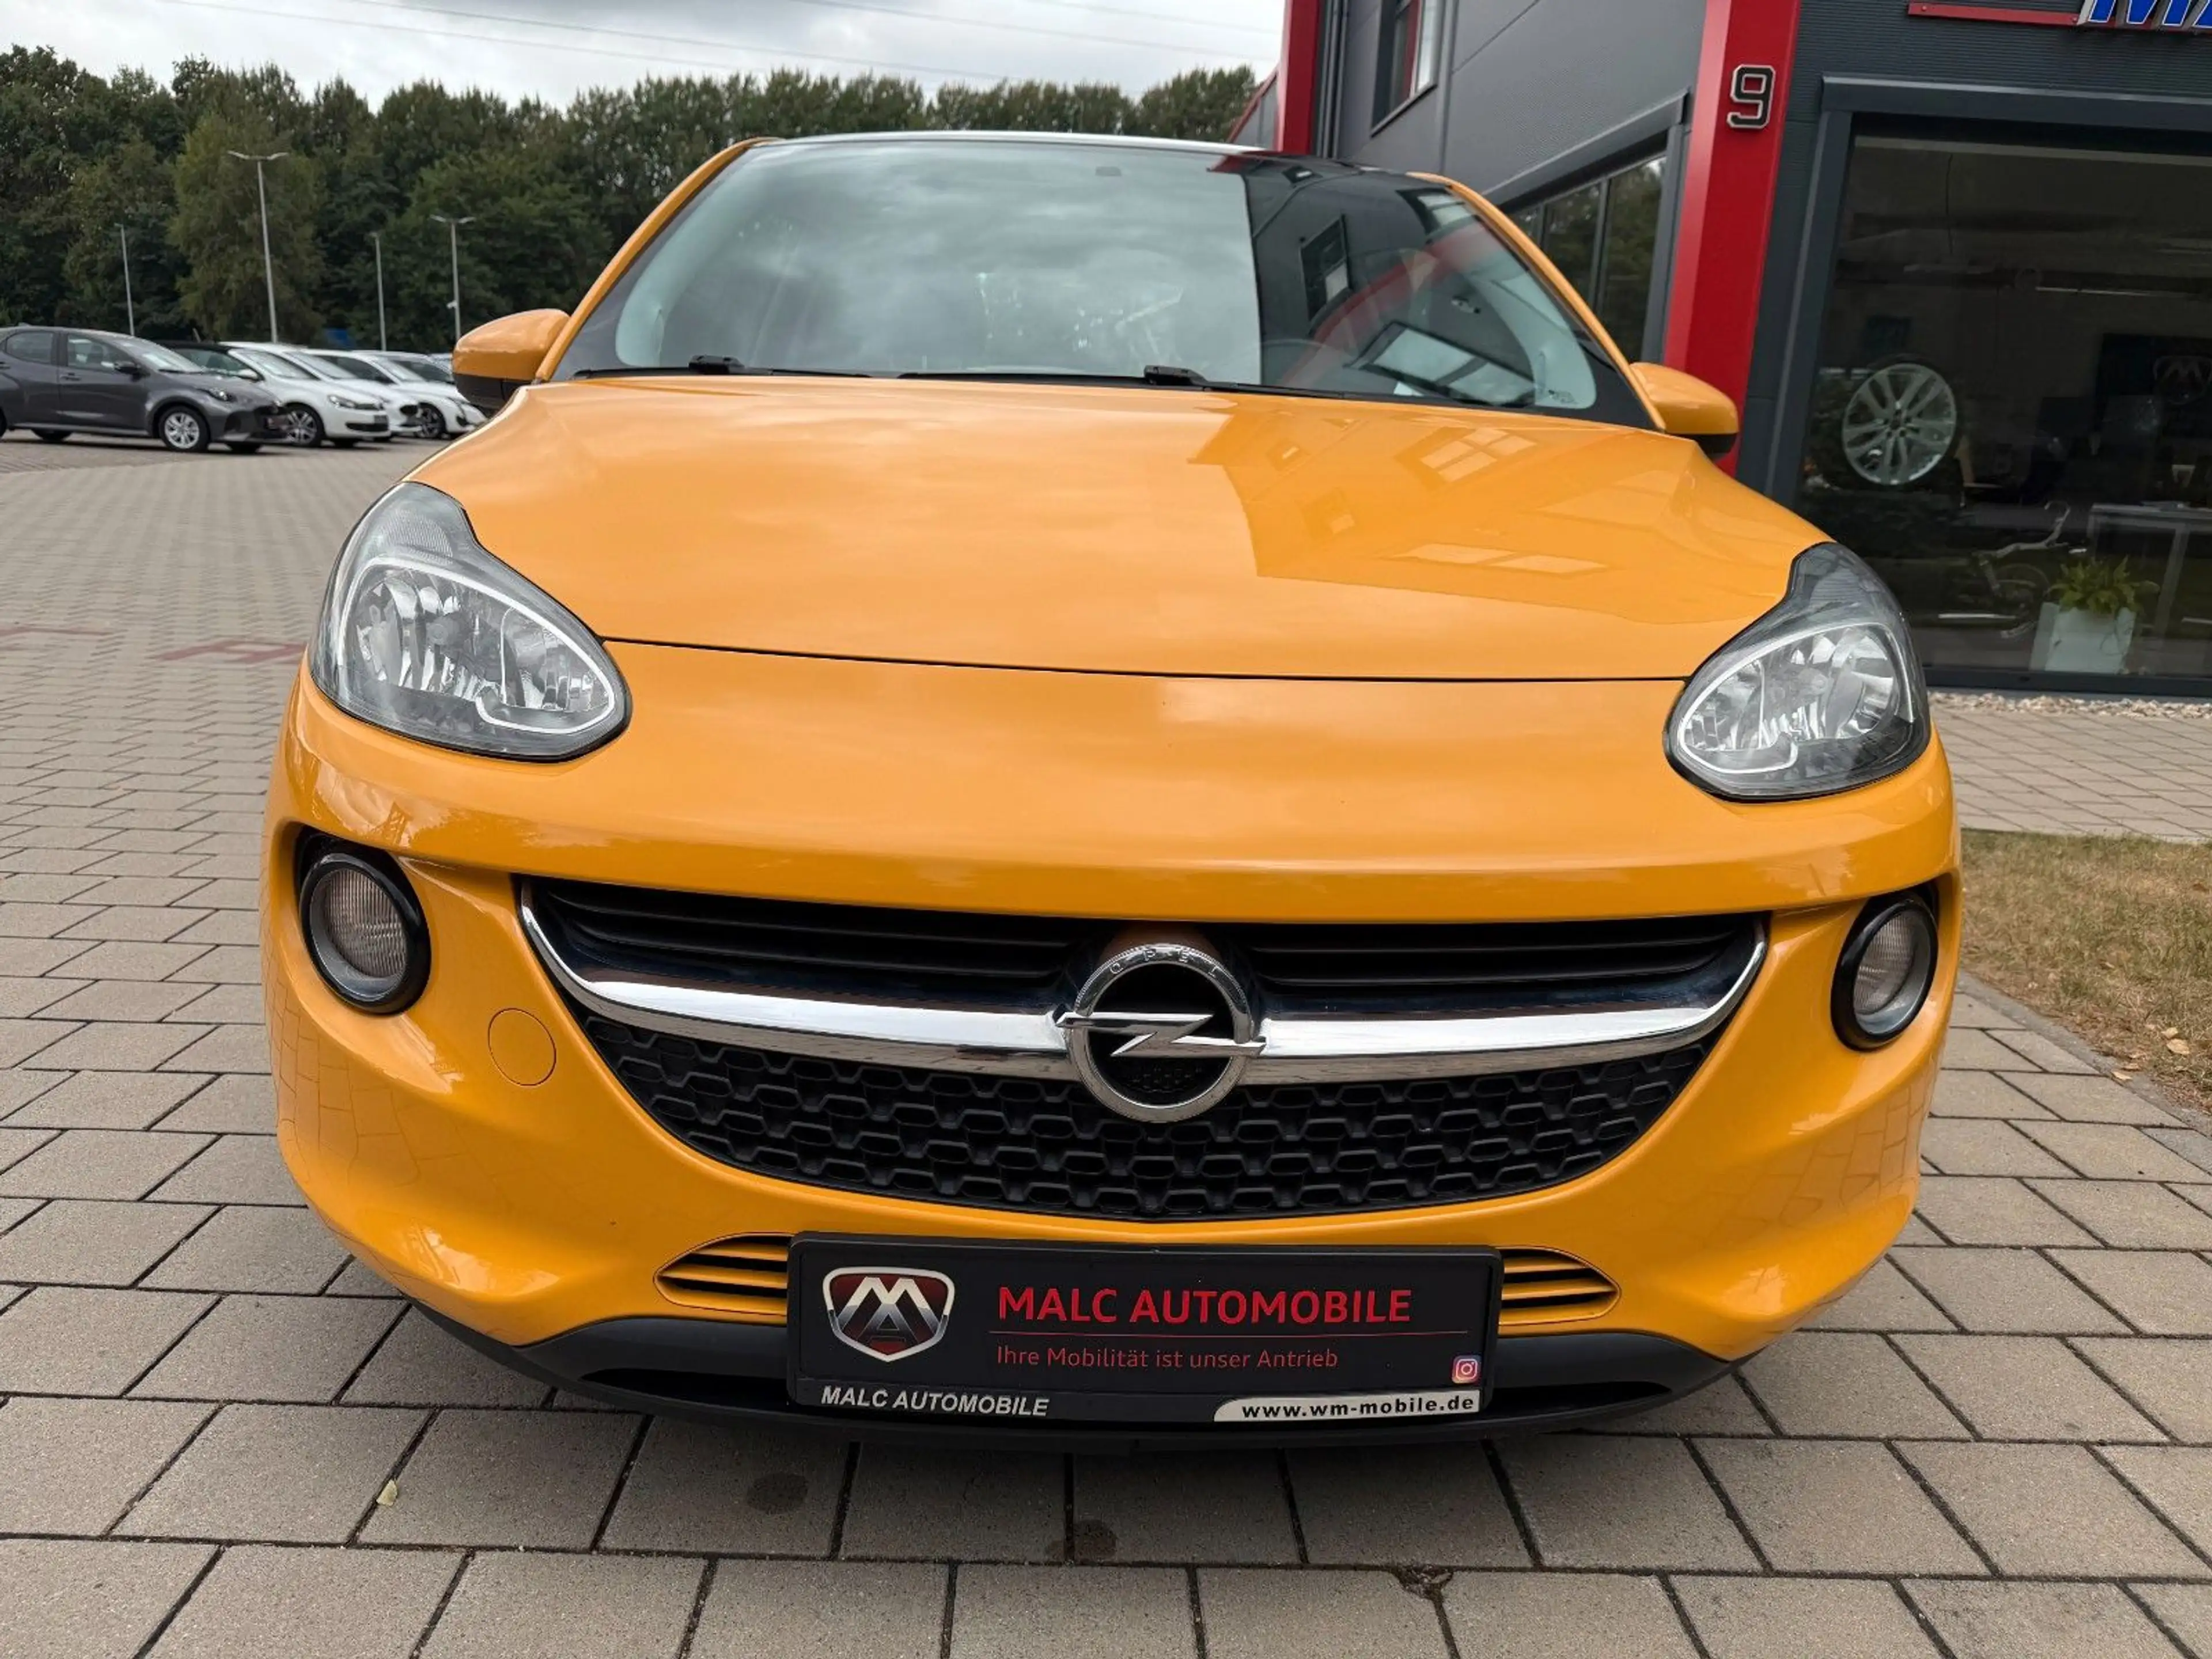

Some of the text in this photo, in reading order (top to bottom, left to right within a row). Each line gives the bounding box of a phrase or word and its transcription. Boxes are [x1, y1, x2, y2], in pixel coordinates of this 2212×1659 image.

[1727, 64, 1775, 129] 9
[1109, 946, 1220, 978] OPEL
[998, 1286, 1412, 1324] MALC AUTOMOBILE
[997, 1346, 1339, 1368] Ihre Mobilität ist unser Antrieb
[821, 1385, 1050, 1417] MALC AUTOMOBILE
[1241, 1395, 1474, 1418] www.wm-mobile.de
